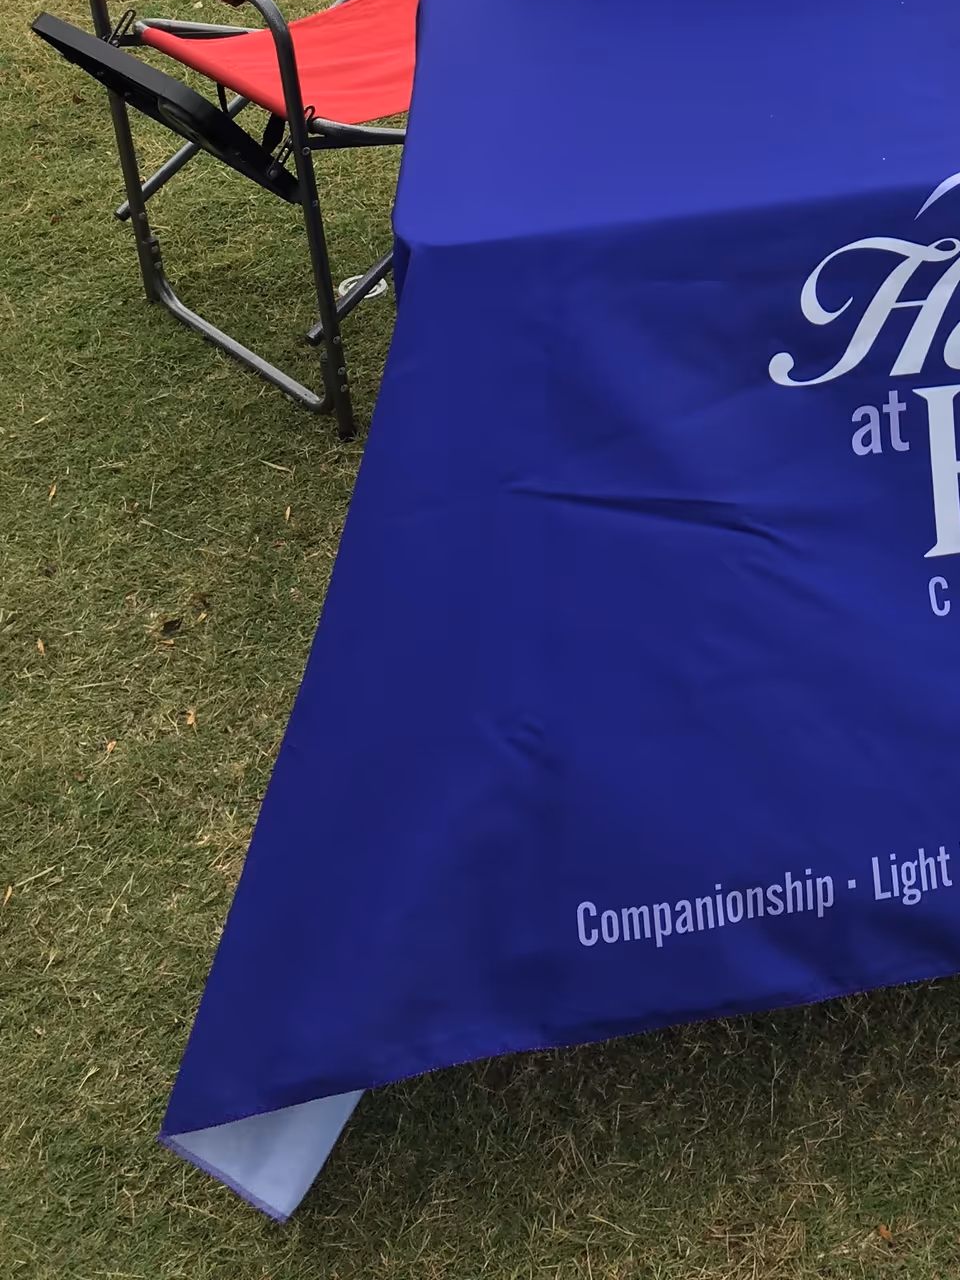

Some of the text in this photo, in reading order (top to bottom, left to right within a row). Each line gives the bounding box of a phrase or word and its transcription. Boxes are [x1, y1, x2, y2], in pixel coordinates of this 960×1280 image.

[850, 389, 910, 456] at
[576, 867, 835, 948] Companionship
[871, 845, 953, 906] Light
